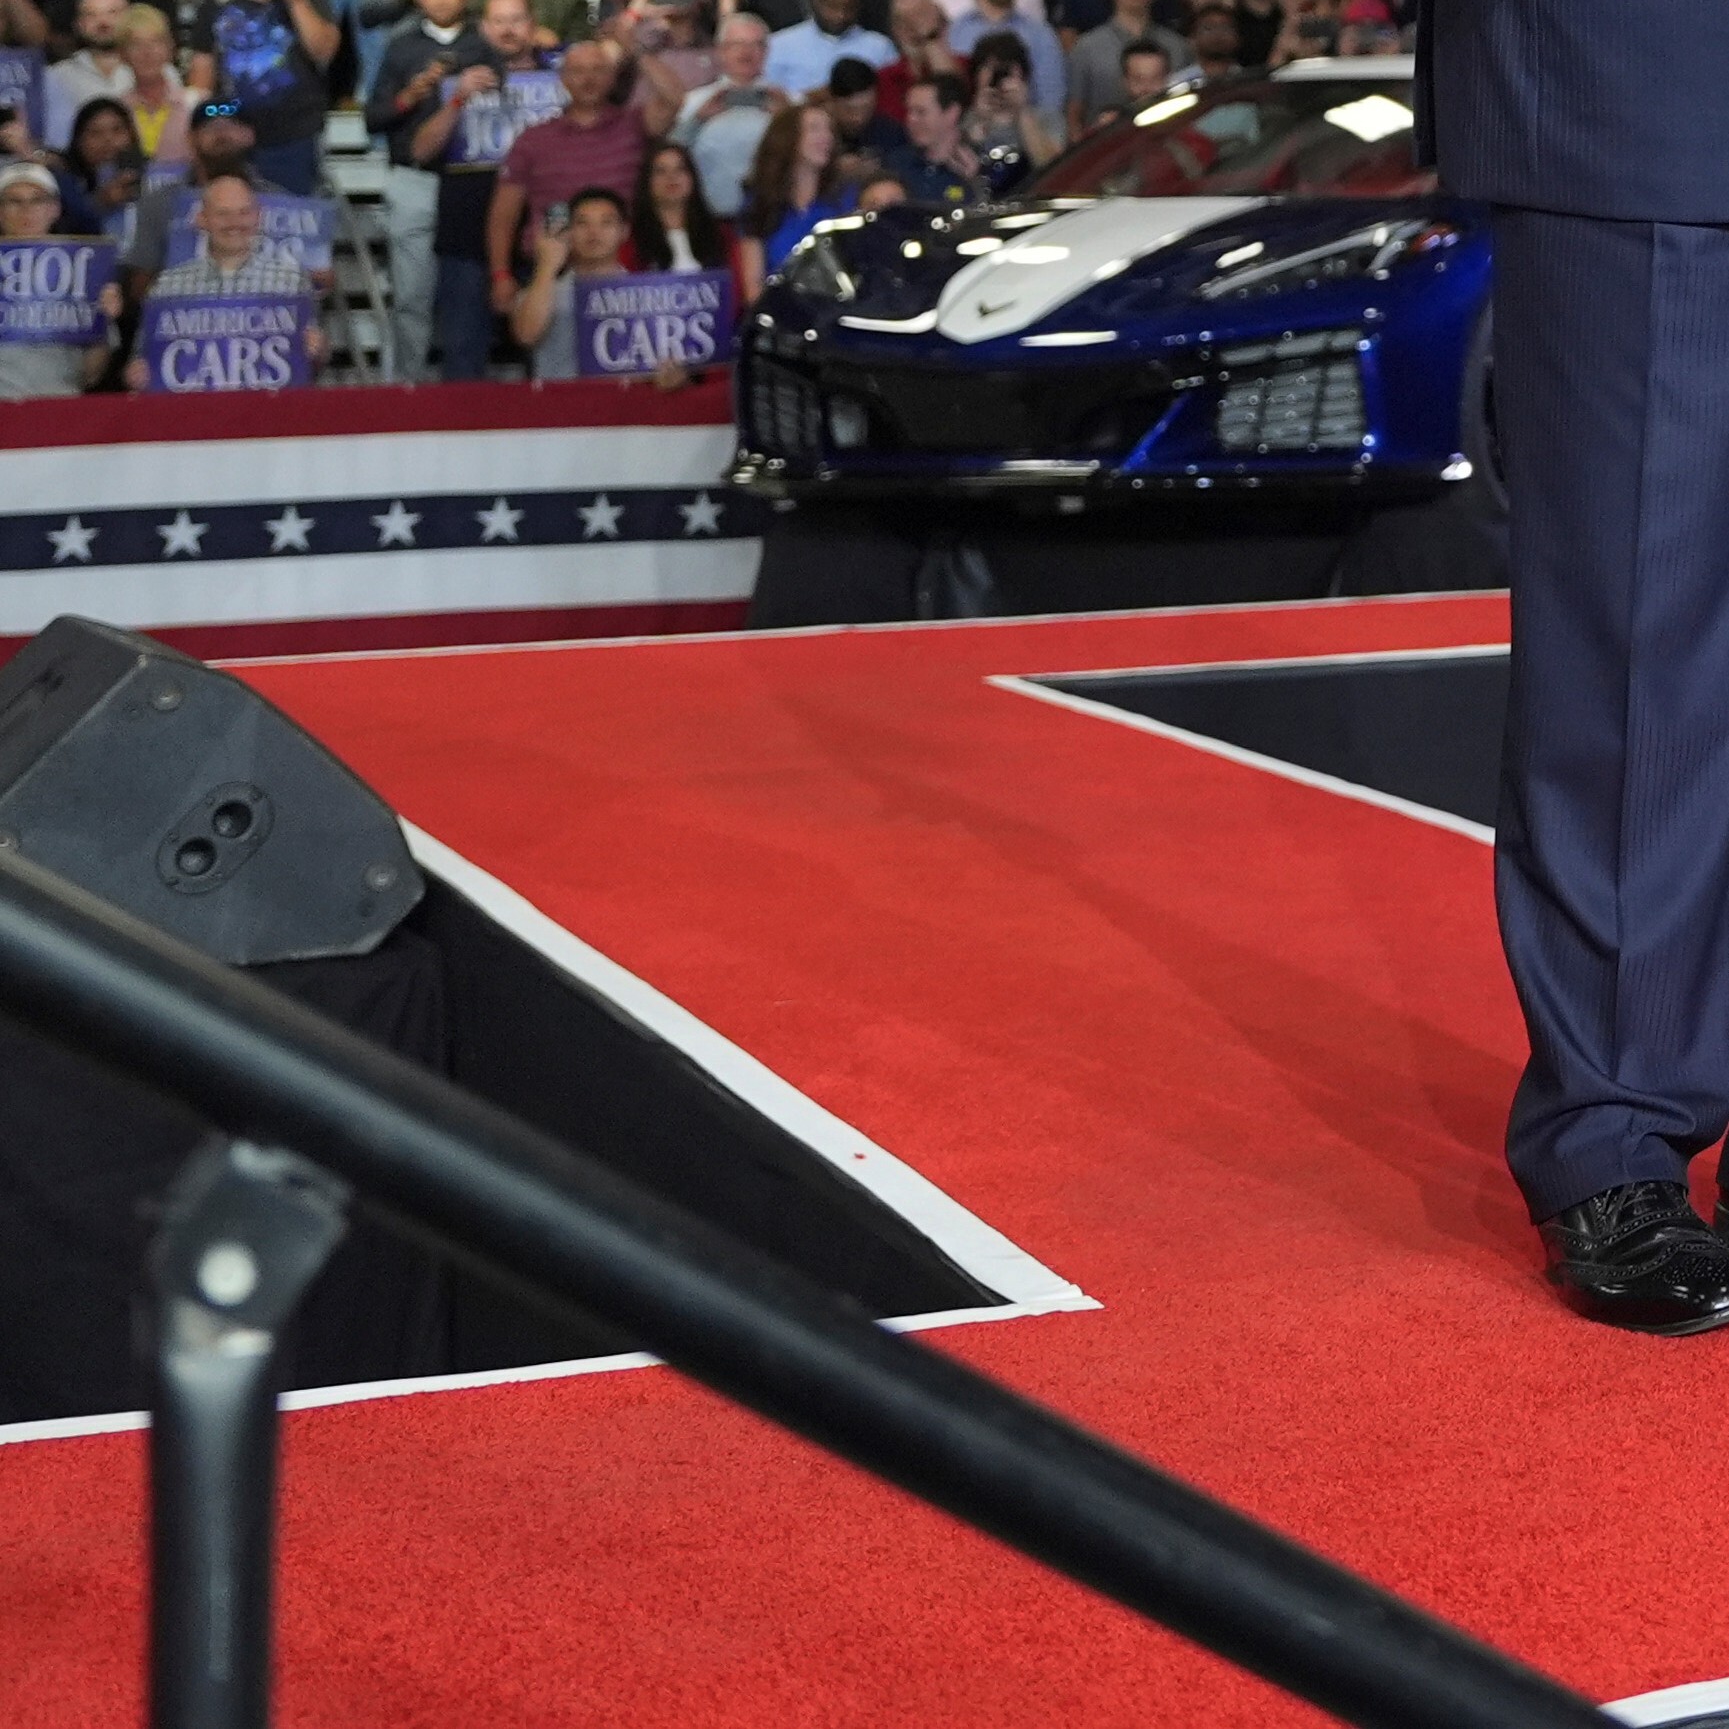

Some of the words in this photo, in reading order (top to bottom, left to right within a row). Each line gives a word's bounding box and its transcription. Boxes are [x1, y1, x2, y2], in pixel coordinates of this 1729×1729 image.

[0, 246, 95, 298] JOB
[160, 334, 293, 393] CARS
[592, 311, 717, 371] CARS
